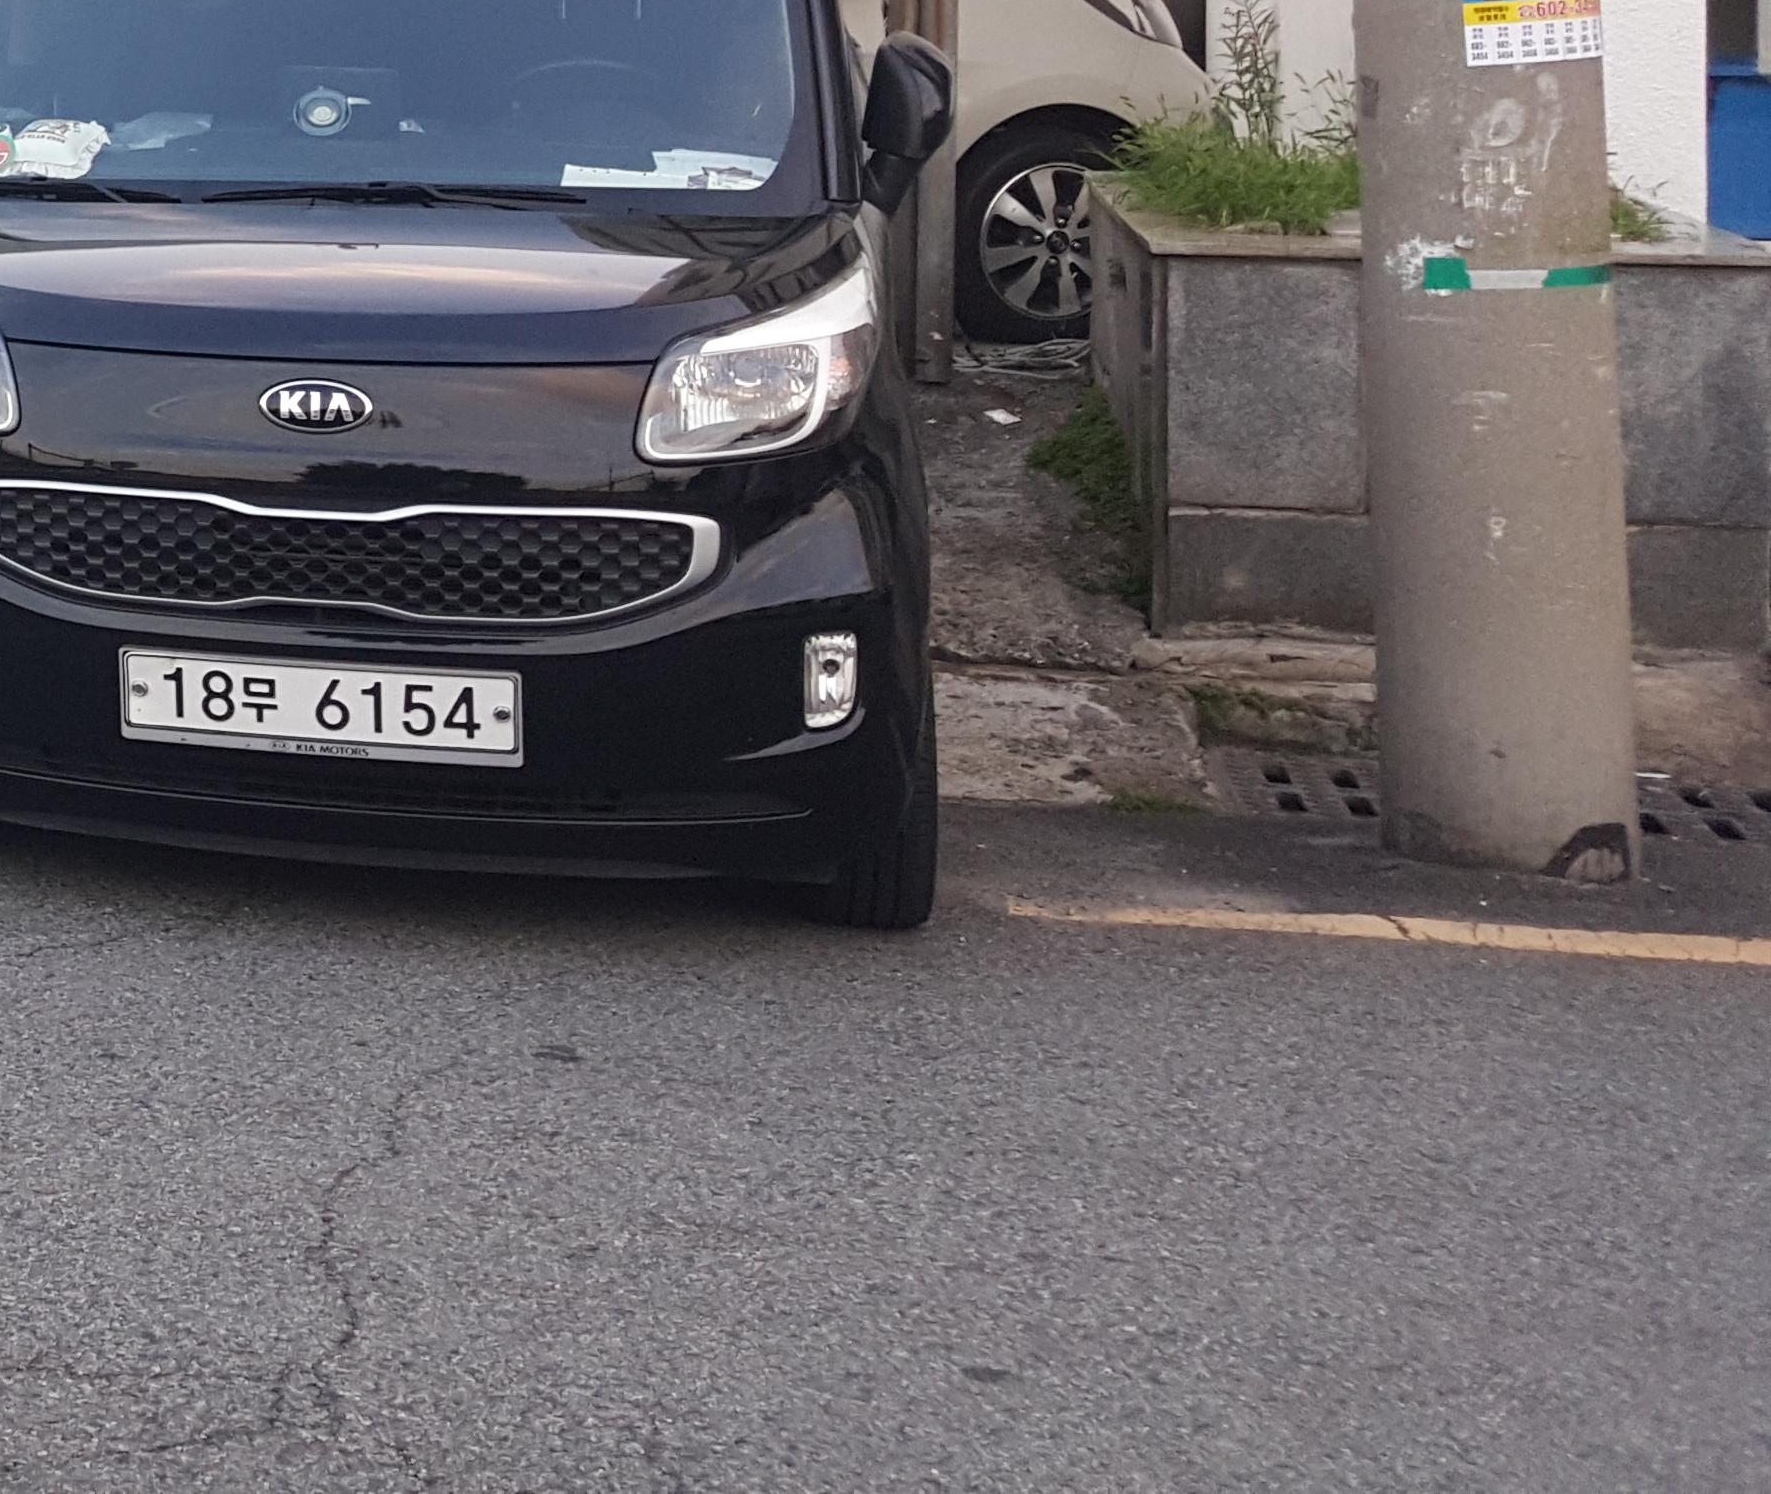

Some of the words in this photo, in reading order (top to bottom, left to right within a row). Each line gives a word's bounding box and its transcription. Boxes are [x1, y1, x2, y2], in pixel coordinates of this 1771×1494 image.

[277, 389, 355, 421] KIA
[163, 666, 279, 723] 18무
[314, 678, 482, 739] 6154
[295, 743, 316, 753] KIA
[319, 744, 370, 758] MOTORS
